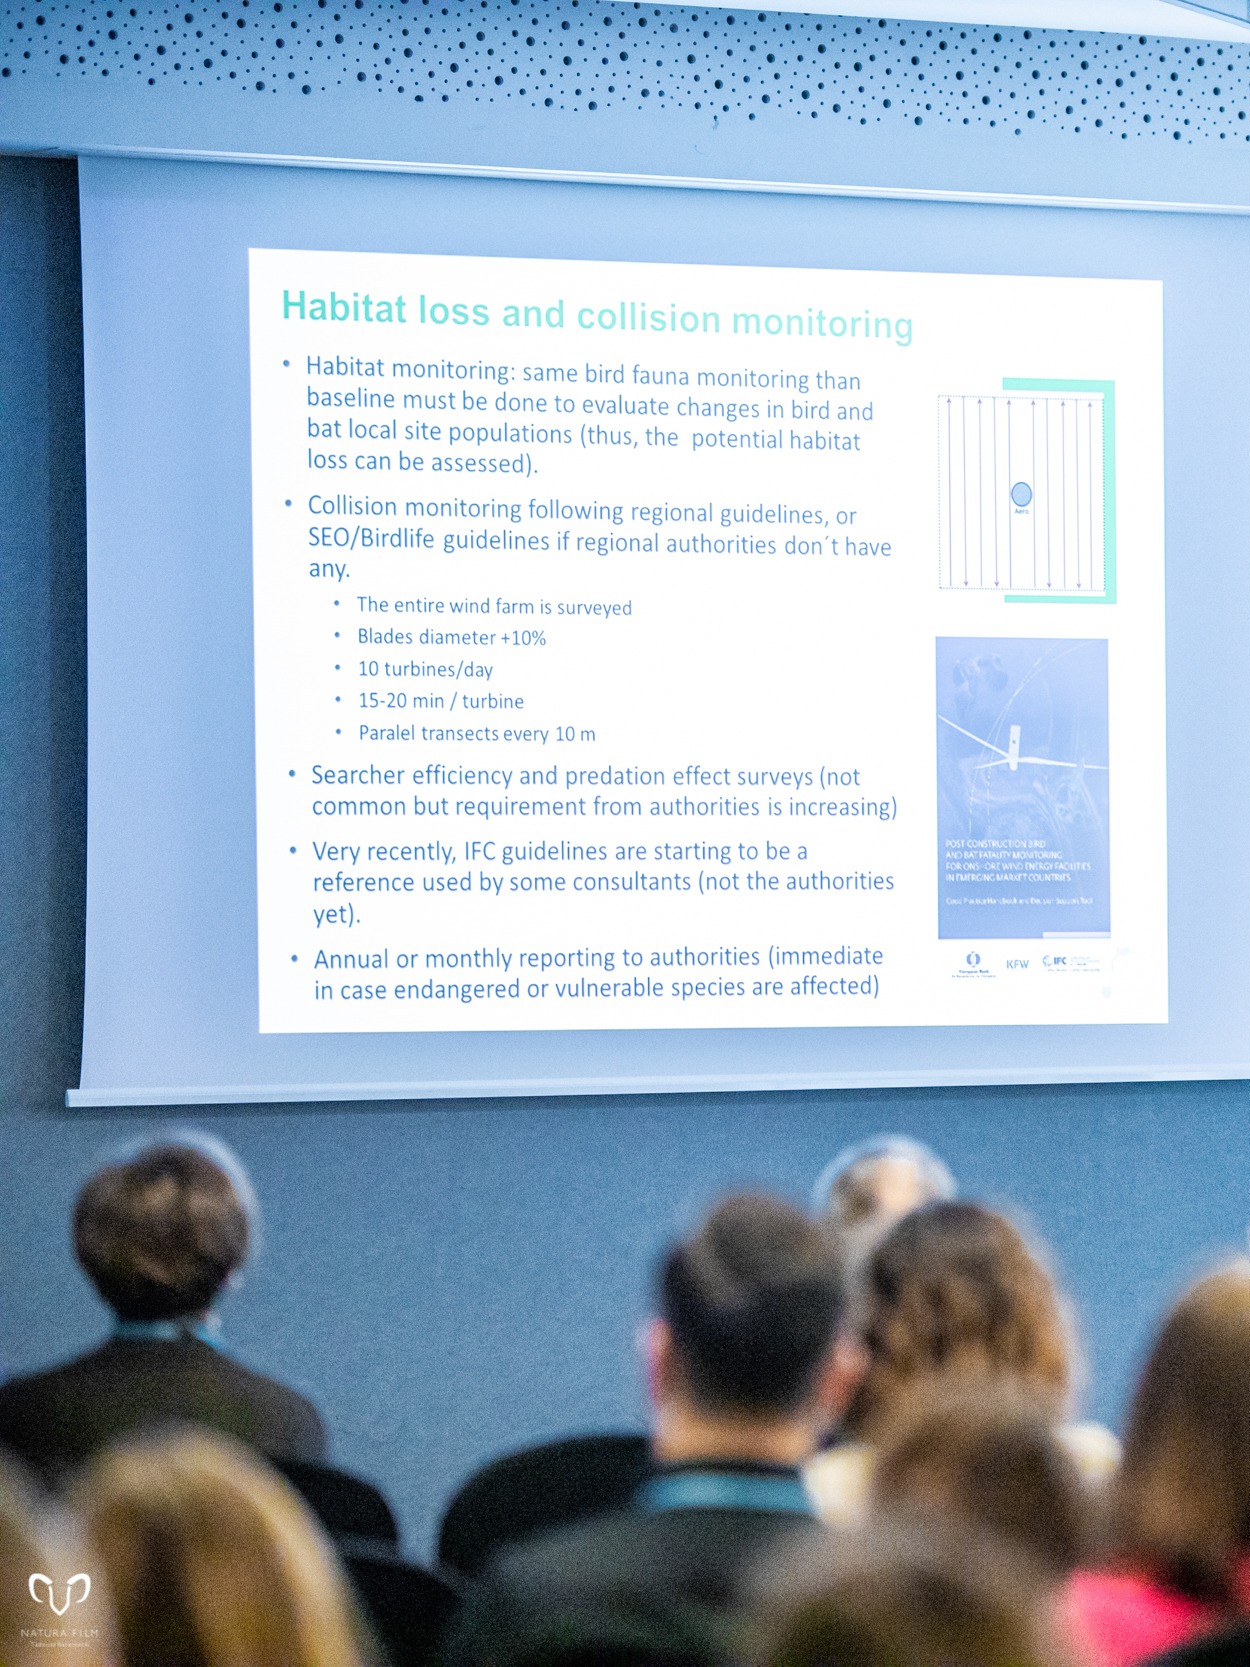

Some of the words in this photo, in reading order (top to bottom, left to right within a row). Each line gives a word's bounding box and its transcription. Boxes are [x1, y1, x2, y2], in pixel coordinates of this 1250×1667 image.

[282, 288, 408, 324] Habitat
[419, 293, 491, 327] loss
[502, 298, 565, 329] and
[577, 300, 721, 334] collision
[732, 307, 913, 348] monitoring
[306, 354, 385, 378] Habitat
[392, 359, 515, 386] monitoring:
[522, 366, 578, 383] same
[585, 362, 625, 384] bird
[632, 363, 689, 386] fauna
[697, 368, 810, 394] monitoring
[815, 369, 861, 391] than
[307, 385, 395, 409] baseline
[403, 392, 457, 411] must
[462, 389, 488, 411] be
[494, 390, 548, 413] done
[553, 395, 576, 414] to
[582, 393, 670, 416] evaluate
[676, 396, 760, 423] changes
[767, 399, 784, 419] in
[791, 399, 830, 420] bird
[837, 401, 873, 421] and
[307, 416, 342, 439] bat
[348, 417, 397, 440] local
[404, 419, 442, 441] site
[449, 421, 573, 447] populations
[580, 423, 638, 449] (thus,
[644, 425, 679, 447] the
[692, 428, 783, 452] potential
[790, 429, 861, 452] habitat
[307, 447, 348, 470] loss
[354, 454, 391, 471] can
[398, 449, 425, 472] be
[431, 452, 538, 479] assessed).
[307, 493, 397, 517] Collision
[405, 497, 522, 524] monitoring
[528, 498, 624, 526] following
[631, 501, 713, 527] regional
[720, 503, 829, 529] guidelines,
[835, 510, 858, 525] or
[308, 524, 435, 551] SEO/Birdlife
[443, 528, 550, 554] guidelines
[557, 530, 571, 551] if
[576, 532, 659, 557] regional
[666, 532, 777, 555] authorities
[845, 535, 892, 557] have
[309, 562, 350, 583] any.
[356, 595, 389, 613] The
[394, 597, 445, 614] entire
[449, 597, 490, 614] wind
[495, 597, 535, 615] farm
[540, 598, 552, 615] is
[557, 599, 632, 620] surveyed
[358, 626, 413, 645] Blades
[419, 627, 497, 646] diameter
[500, 629, 547, 646] +10%
[359, 660, 379, 677] 10
[384, 659, 494, 682] turbines/day
[359, 691, 408, 709] 15-20
[413, 692, 445, 709] min
[462, 692, 525, 710] turbine
[359, 723, 415, 741] Paralel
[421, 726, 499, 742] transects
[503, 729, 550, 746] every
[556, 725, 576, 742] 10
[580, 729, 596, 742] m
[311, 763, 406, 785] Searcher
[412, 763, 513, 790] efficiency
[519, 764, 558, 786] and
[565, 764, 665, 790] predation
[672, 764, 731, 786] effect
[737, 771, 814, 791] surveys
[819, 765, 861, 791] (not
[312, 800, 406, 816] common
[413, 794, 449, 816] but
[455, 795, 587, 821] requirement
[592, 794, 642, 816] from
[649, 795, 760, 817] authorities
[768, 796, 783, 817] is
[789, 795, 897, 821] increasing)
[311, 840, 361, 866] Very
[367, 840, 457, 866] recently,
[465, 840, 496, 861] IFC
[501, 839, 608, 866] guidelines
[615, 845, 648, 861] are
[654, 840, 732, 866] starting
[737, 842, 759, 861] to
[766, 840, 791, 861] be
[797, 845, 808, 861] a
[945, 839, 965, 848] POST
[967, 839, 1027, 848] CONSTRUCTION
[313, 870, 415, 893] reference
[422, 870, 472, 892] used
[479, 870, 504, 897] by
[509, 876, 566, 892] some
[572, 870, 692, 892] consultants
[698, 869, 740, 896] (not
[746, 870, 780, 891] the
[786, 869, 895, 891] authorities
[312, 901, 361, 929] yet).
[313, 947, 389, 970] Annual
[396, 953, 419, 969] or
[425, 946, 513, 973] monthly
[519, 947, 616, 973] reporting
[621, 948, 644, 967] to
[650, 945, 760, 967] authorities
[768, 944, 884, 970] (immediate
[1053, 957, 1067, 965] IFC
[315, 979, 333, 1001] in
[340, 984, 387, 1001] case
[393, 977, 520, 1004] endangered
[527, 983, 550, 999] or
[554, 976, 664, 998] vulnerable
[671, 976, 746, 1002] species
[751, 981, 784, 996] are
[790, 974, 879, 1000] affected)
